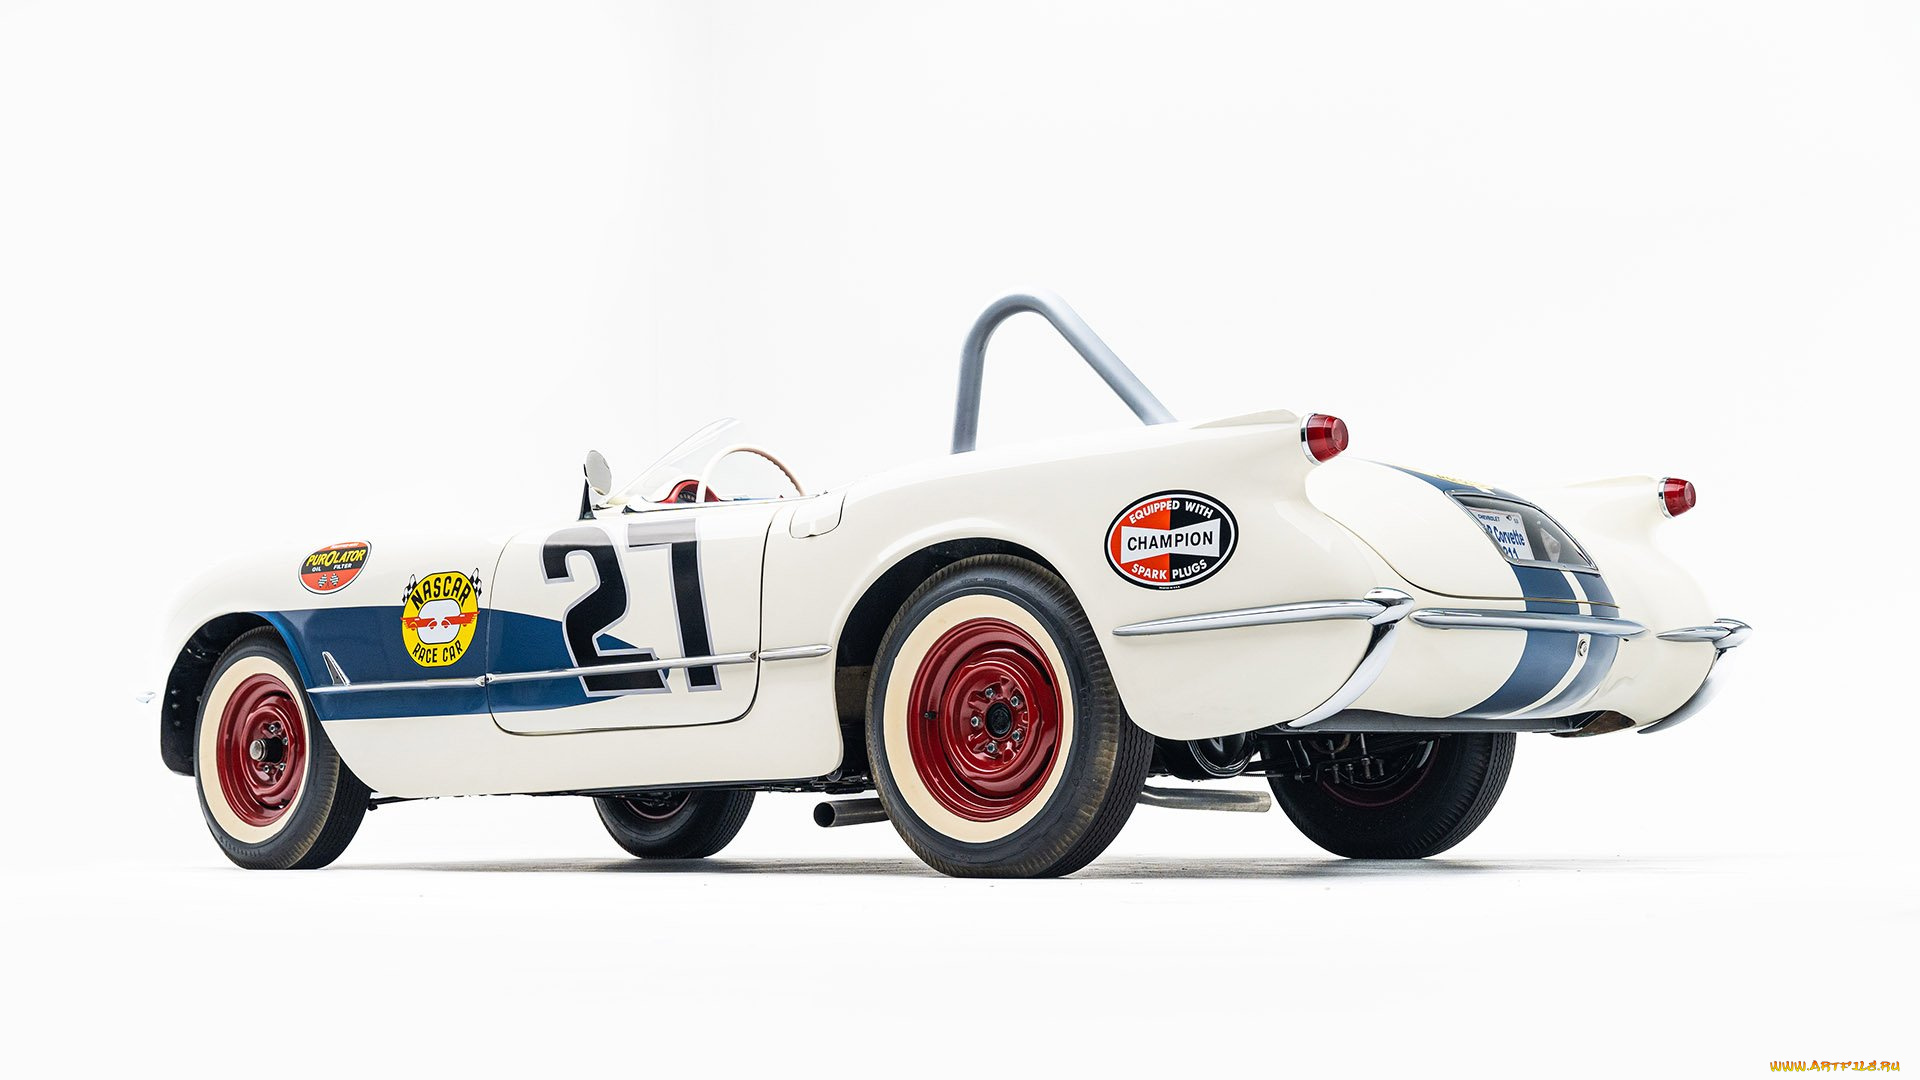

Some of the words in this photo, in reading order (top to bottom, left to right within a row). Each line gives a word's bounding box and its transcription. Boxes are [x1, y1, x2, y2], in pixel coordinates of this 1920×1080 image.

[1129, 500, 1180, 524] EQUIPPED
[1185, 501, 1214, 519] WITH
[1127, 530, 1213, 551] CHAMPION
[1493, 526, 1525, 546] Corvette
[306, 550, 366, 567] PUROLATOR
[1131, 563, 1168, 580] SPARK
[1171, 558, 1208, 580] PLUGS
[411, 576, 471, 610] NASCAR
[539, 517, 722, 698] 27
[412, 642, 438, 664] RACE
[442, 639, 463, 663] CAR
